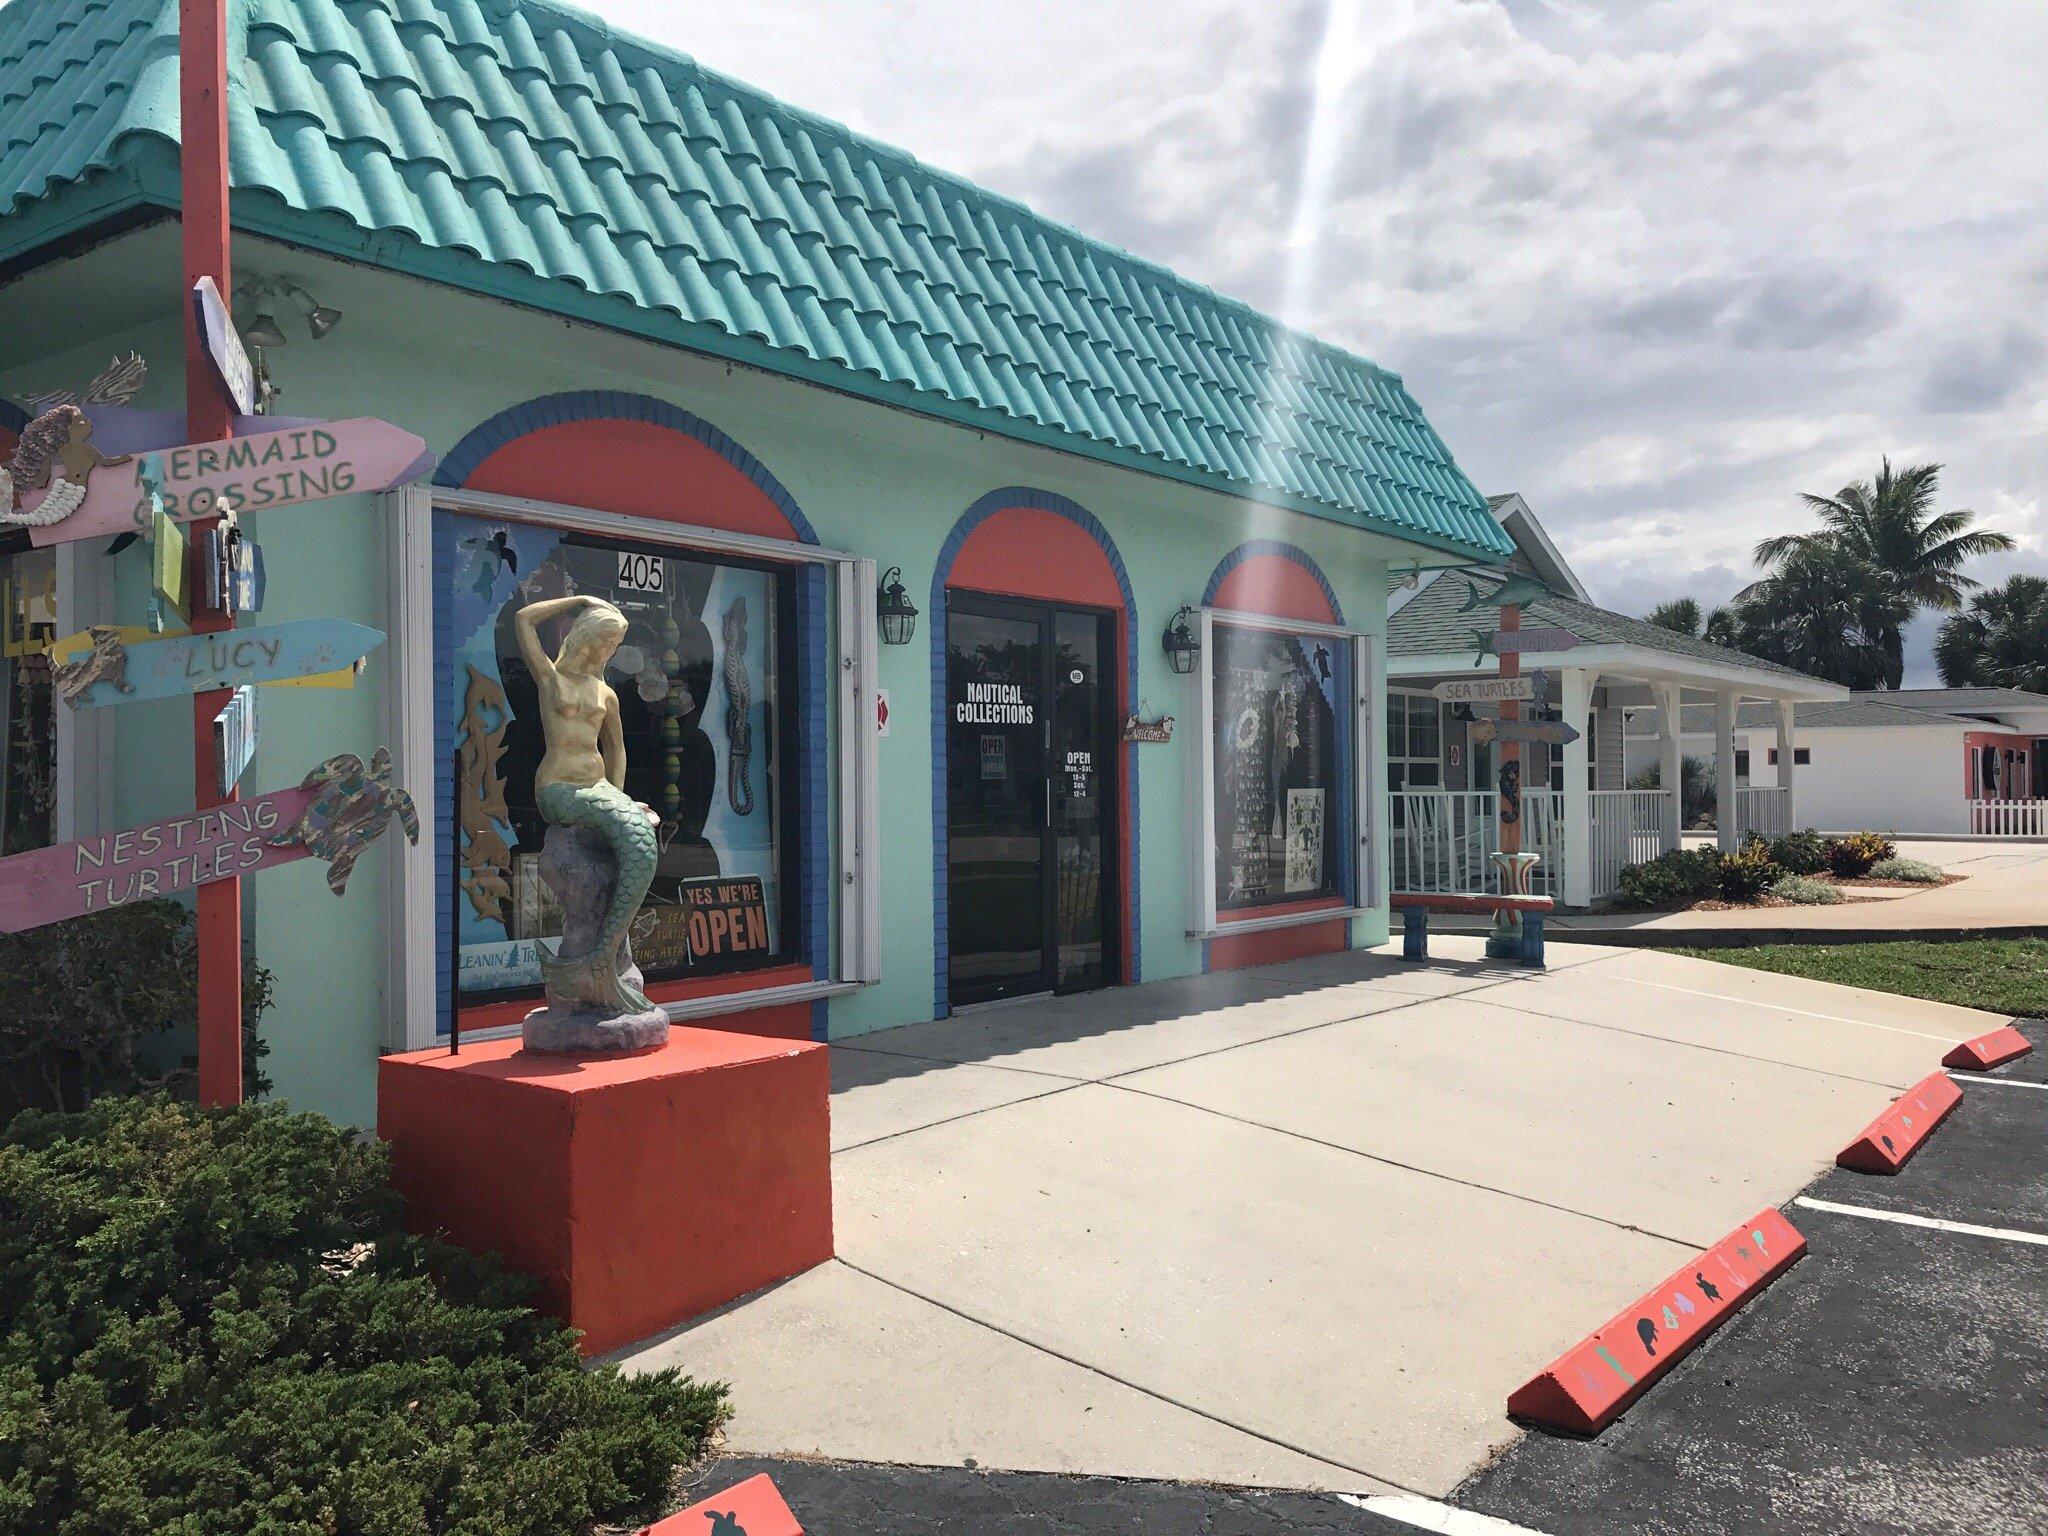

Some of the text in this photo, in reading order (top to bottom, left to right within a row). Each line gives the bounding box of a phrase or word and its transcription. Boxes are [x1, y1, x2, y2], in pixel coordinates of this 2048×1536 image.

[619, 555, 663, 591] 405
[185, 638, 281, 677] LUCY
[967, 682, 1024, 704] NAUTICAL
[1445, 680, 1526, 699] SEA TURTLES
[957, 703, 1034, 724] COLLECTIONS
[1133, 729, 1162, 741] WELCOME
[1067, 752, 1091, 764] OPEN
[75, 801, 279, 875] NESTING
[77, 836, 263, 910] TURTLES
[686, 883, 759, 905] YES WE'RE
[666, 912, 685, 924] SEA
[689, 905, 767, 956] OPEN
